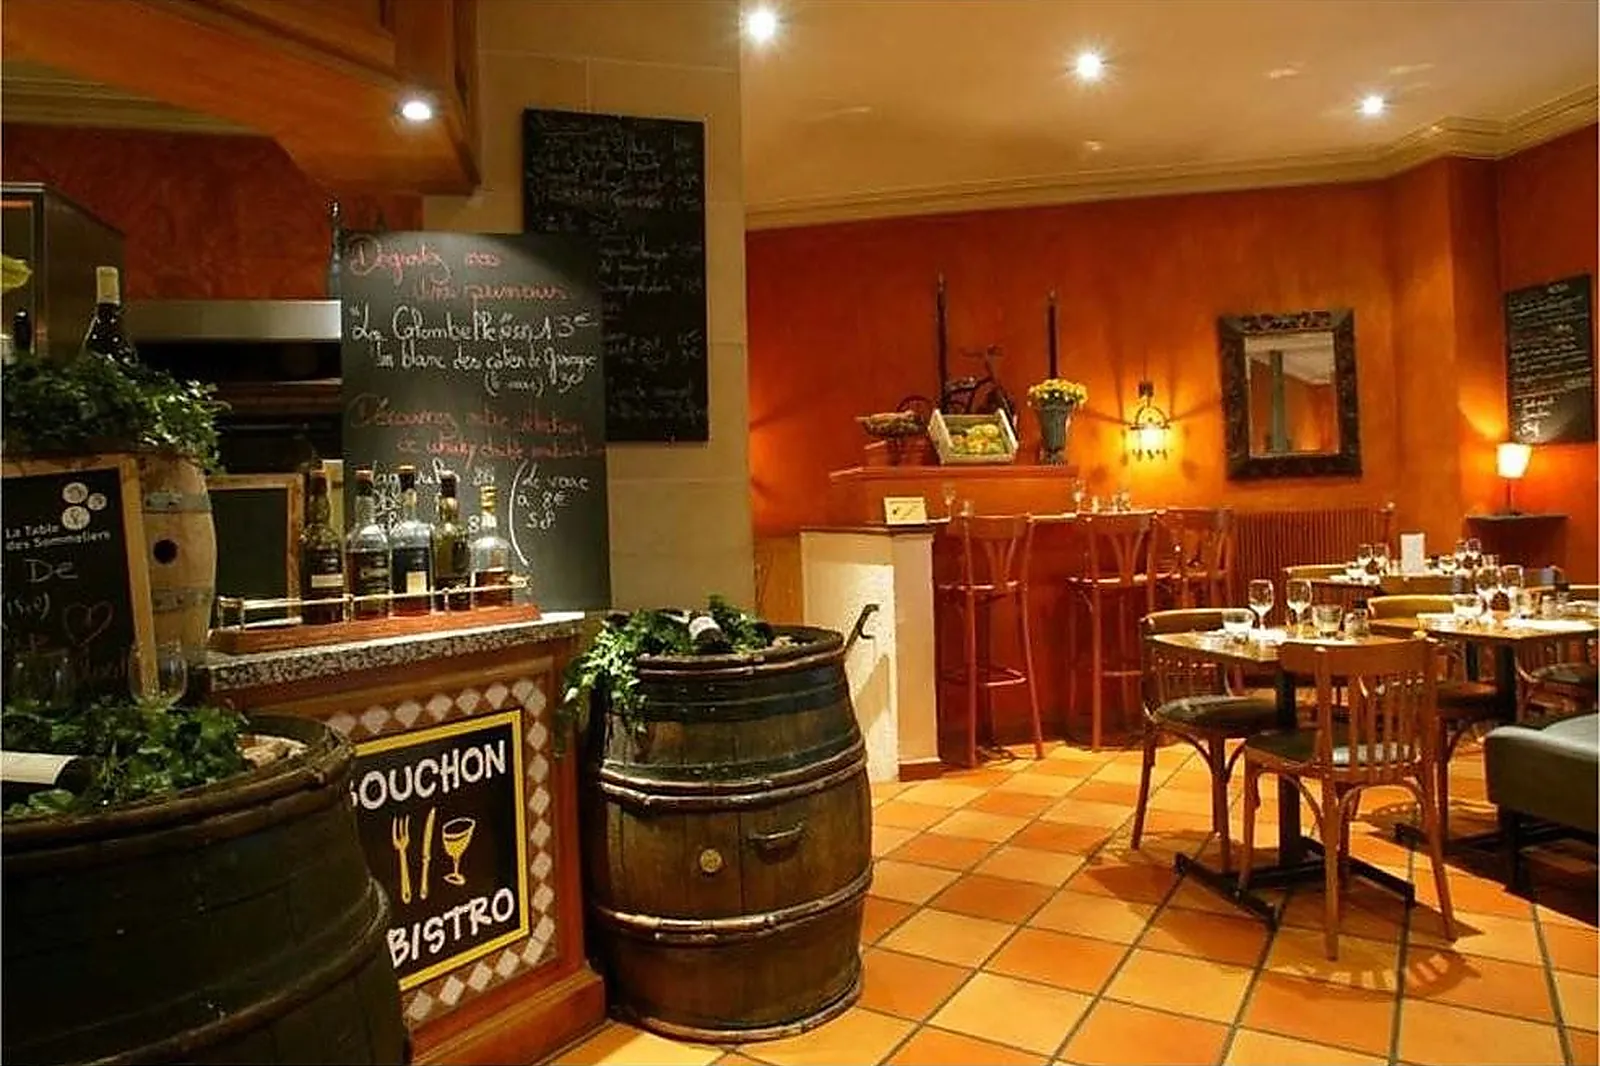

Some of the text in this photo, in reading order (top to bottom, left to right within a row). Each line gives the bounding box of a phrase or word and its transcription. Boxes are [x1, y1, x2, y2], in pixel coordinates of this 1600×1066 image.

[5, 523, 59, 539] La Table
[6, 529, 111, 551] des Sommeliers
[387, 887, 515, 969] BISTRO
